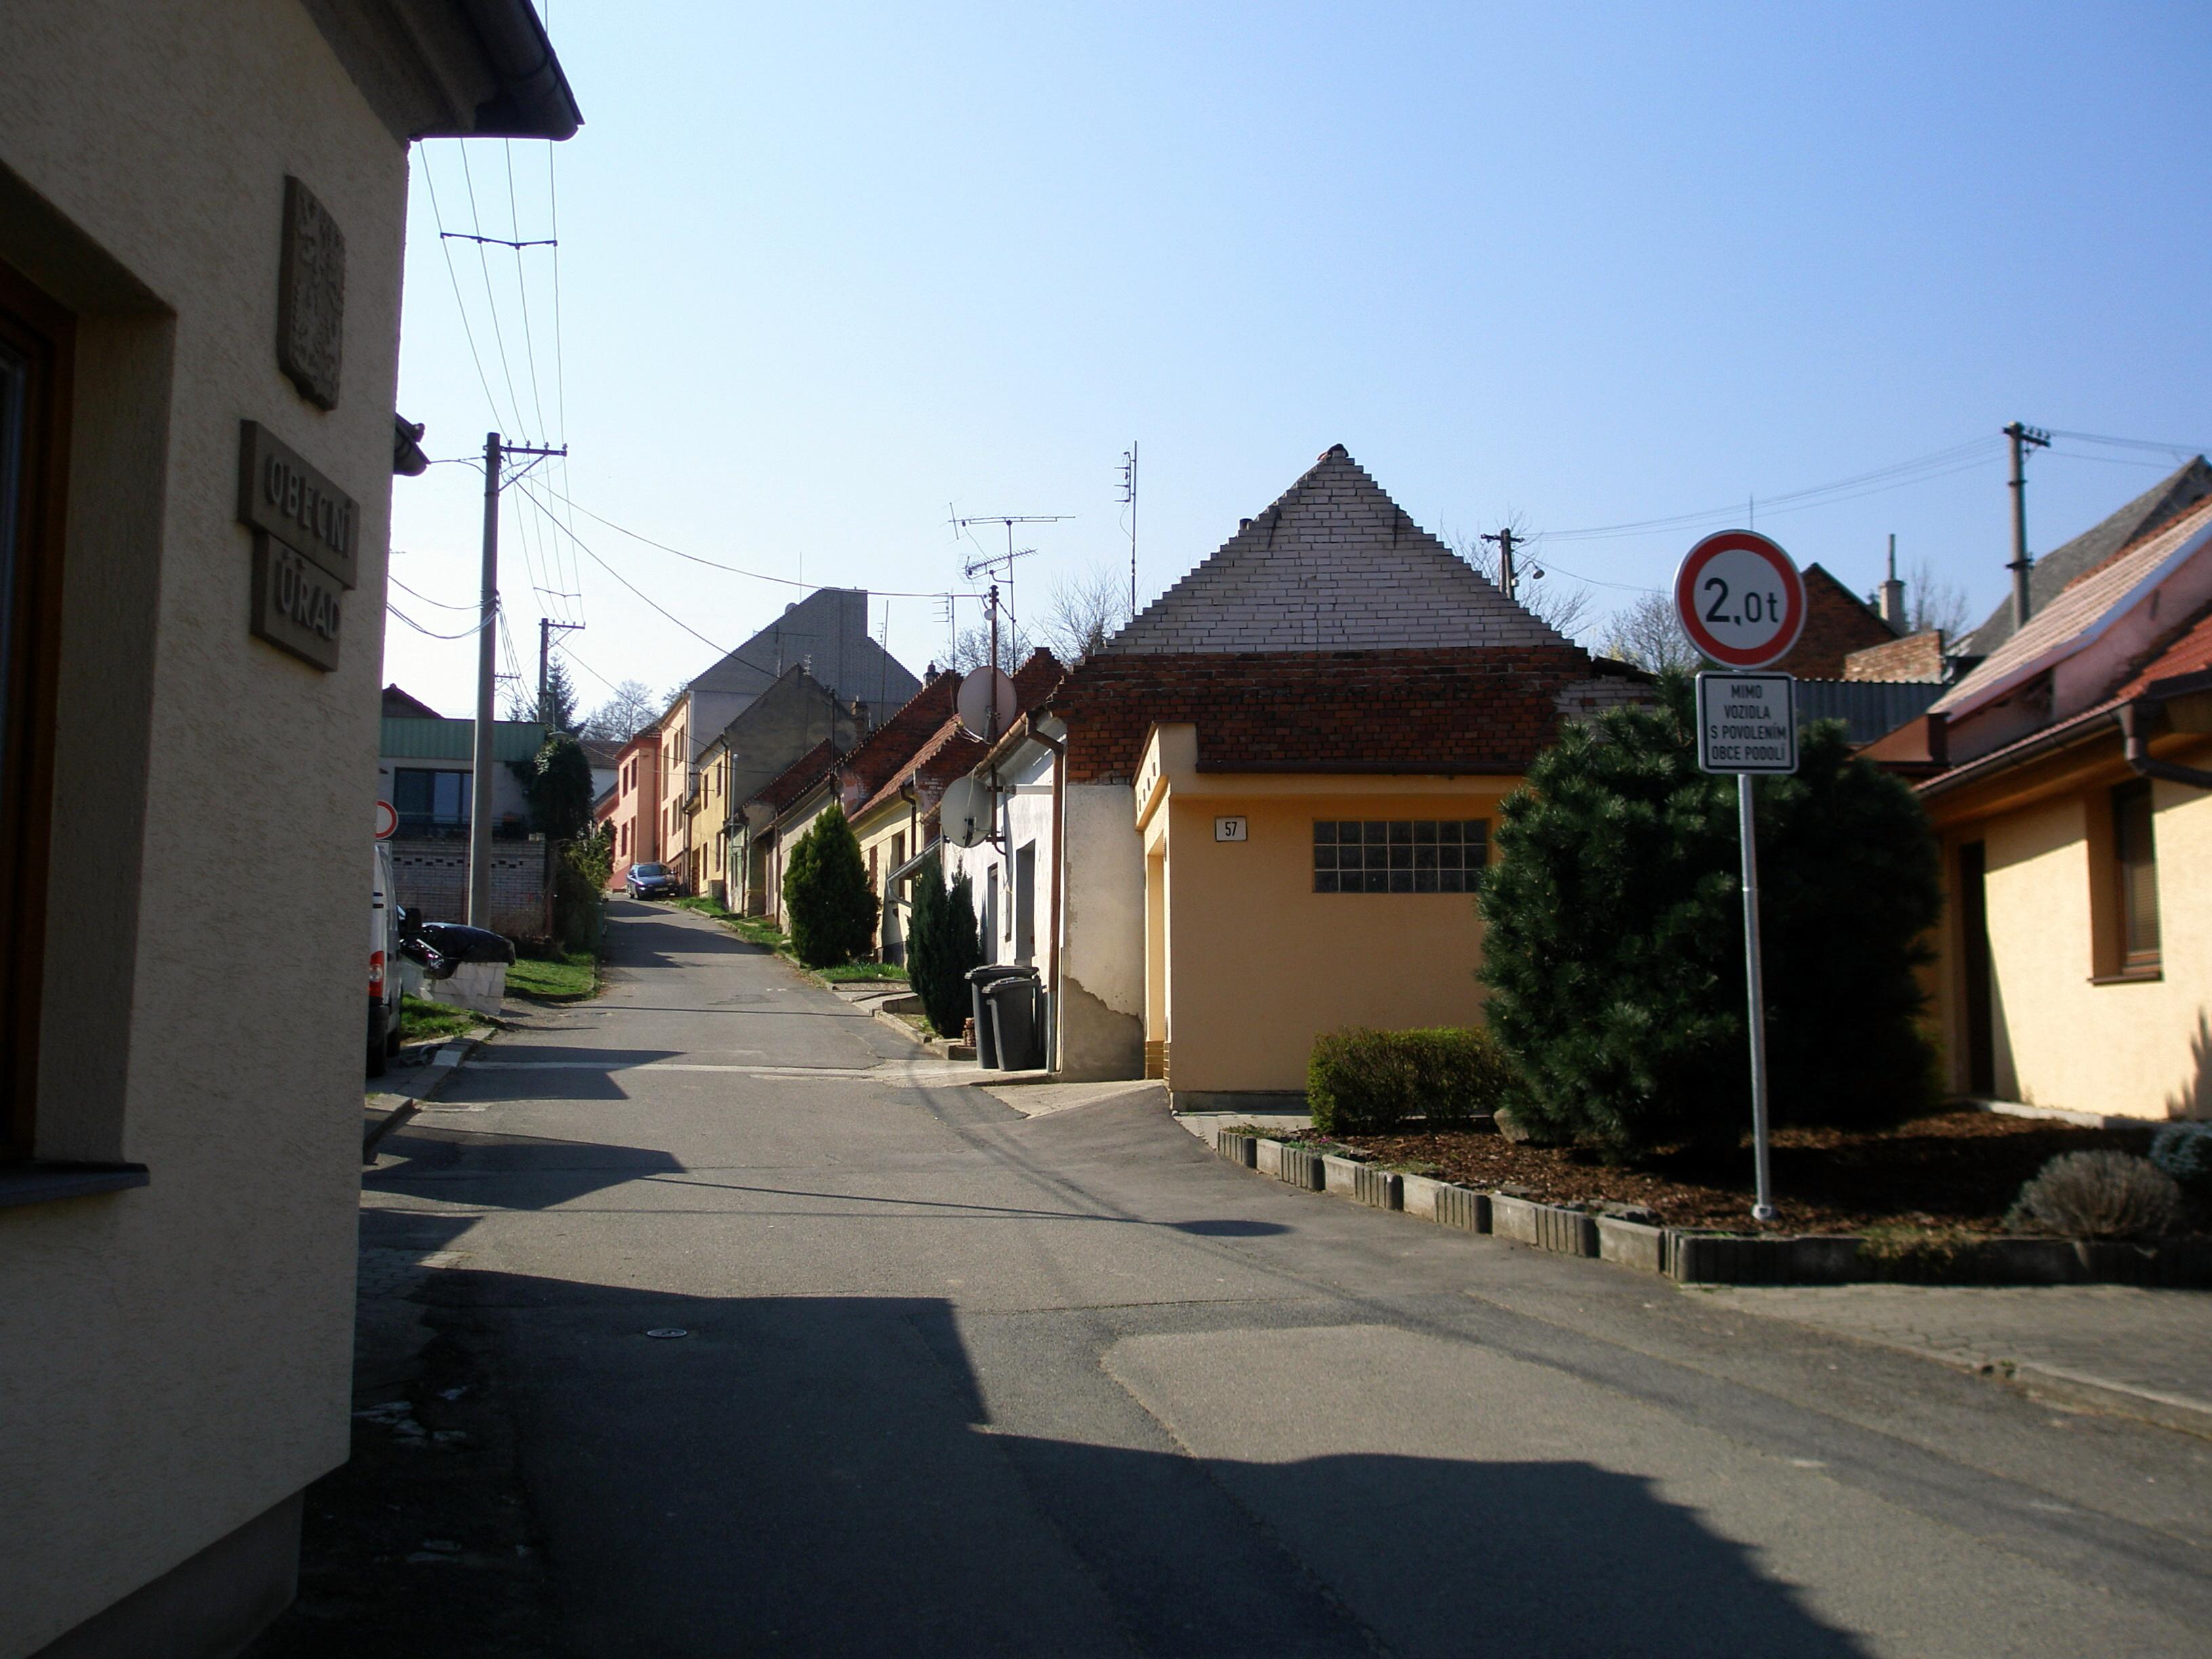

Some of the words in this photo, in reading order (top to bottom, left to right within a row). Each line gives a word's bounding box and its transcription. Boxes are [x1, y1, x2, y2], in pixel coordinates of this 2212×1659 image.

[265, 455, 352, 558] OBECNÍ
[1731, 684, 1762, 699] MIMO
[1724, 705, 1771, 719] VOZIDLA
[1711, 725, 1718, 739] S
[1722, 722, 1786, 739] POVOLENÍM
[1712, 746, 1741, 760] OBCE
[1745, 743, 1785, 760] PODOLÍ
[1225, 821, 1237, 836] 57
